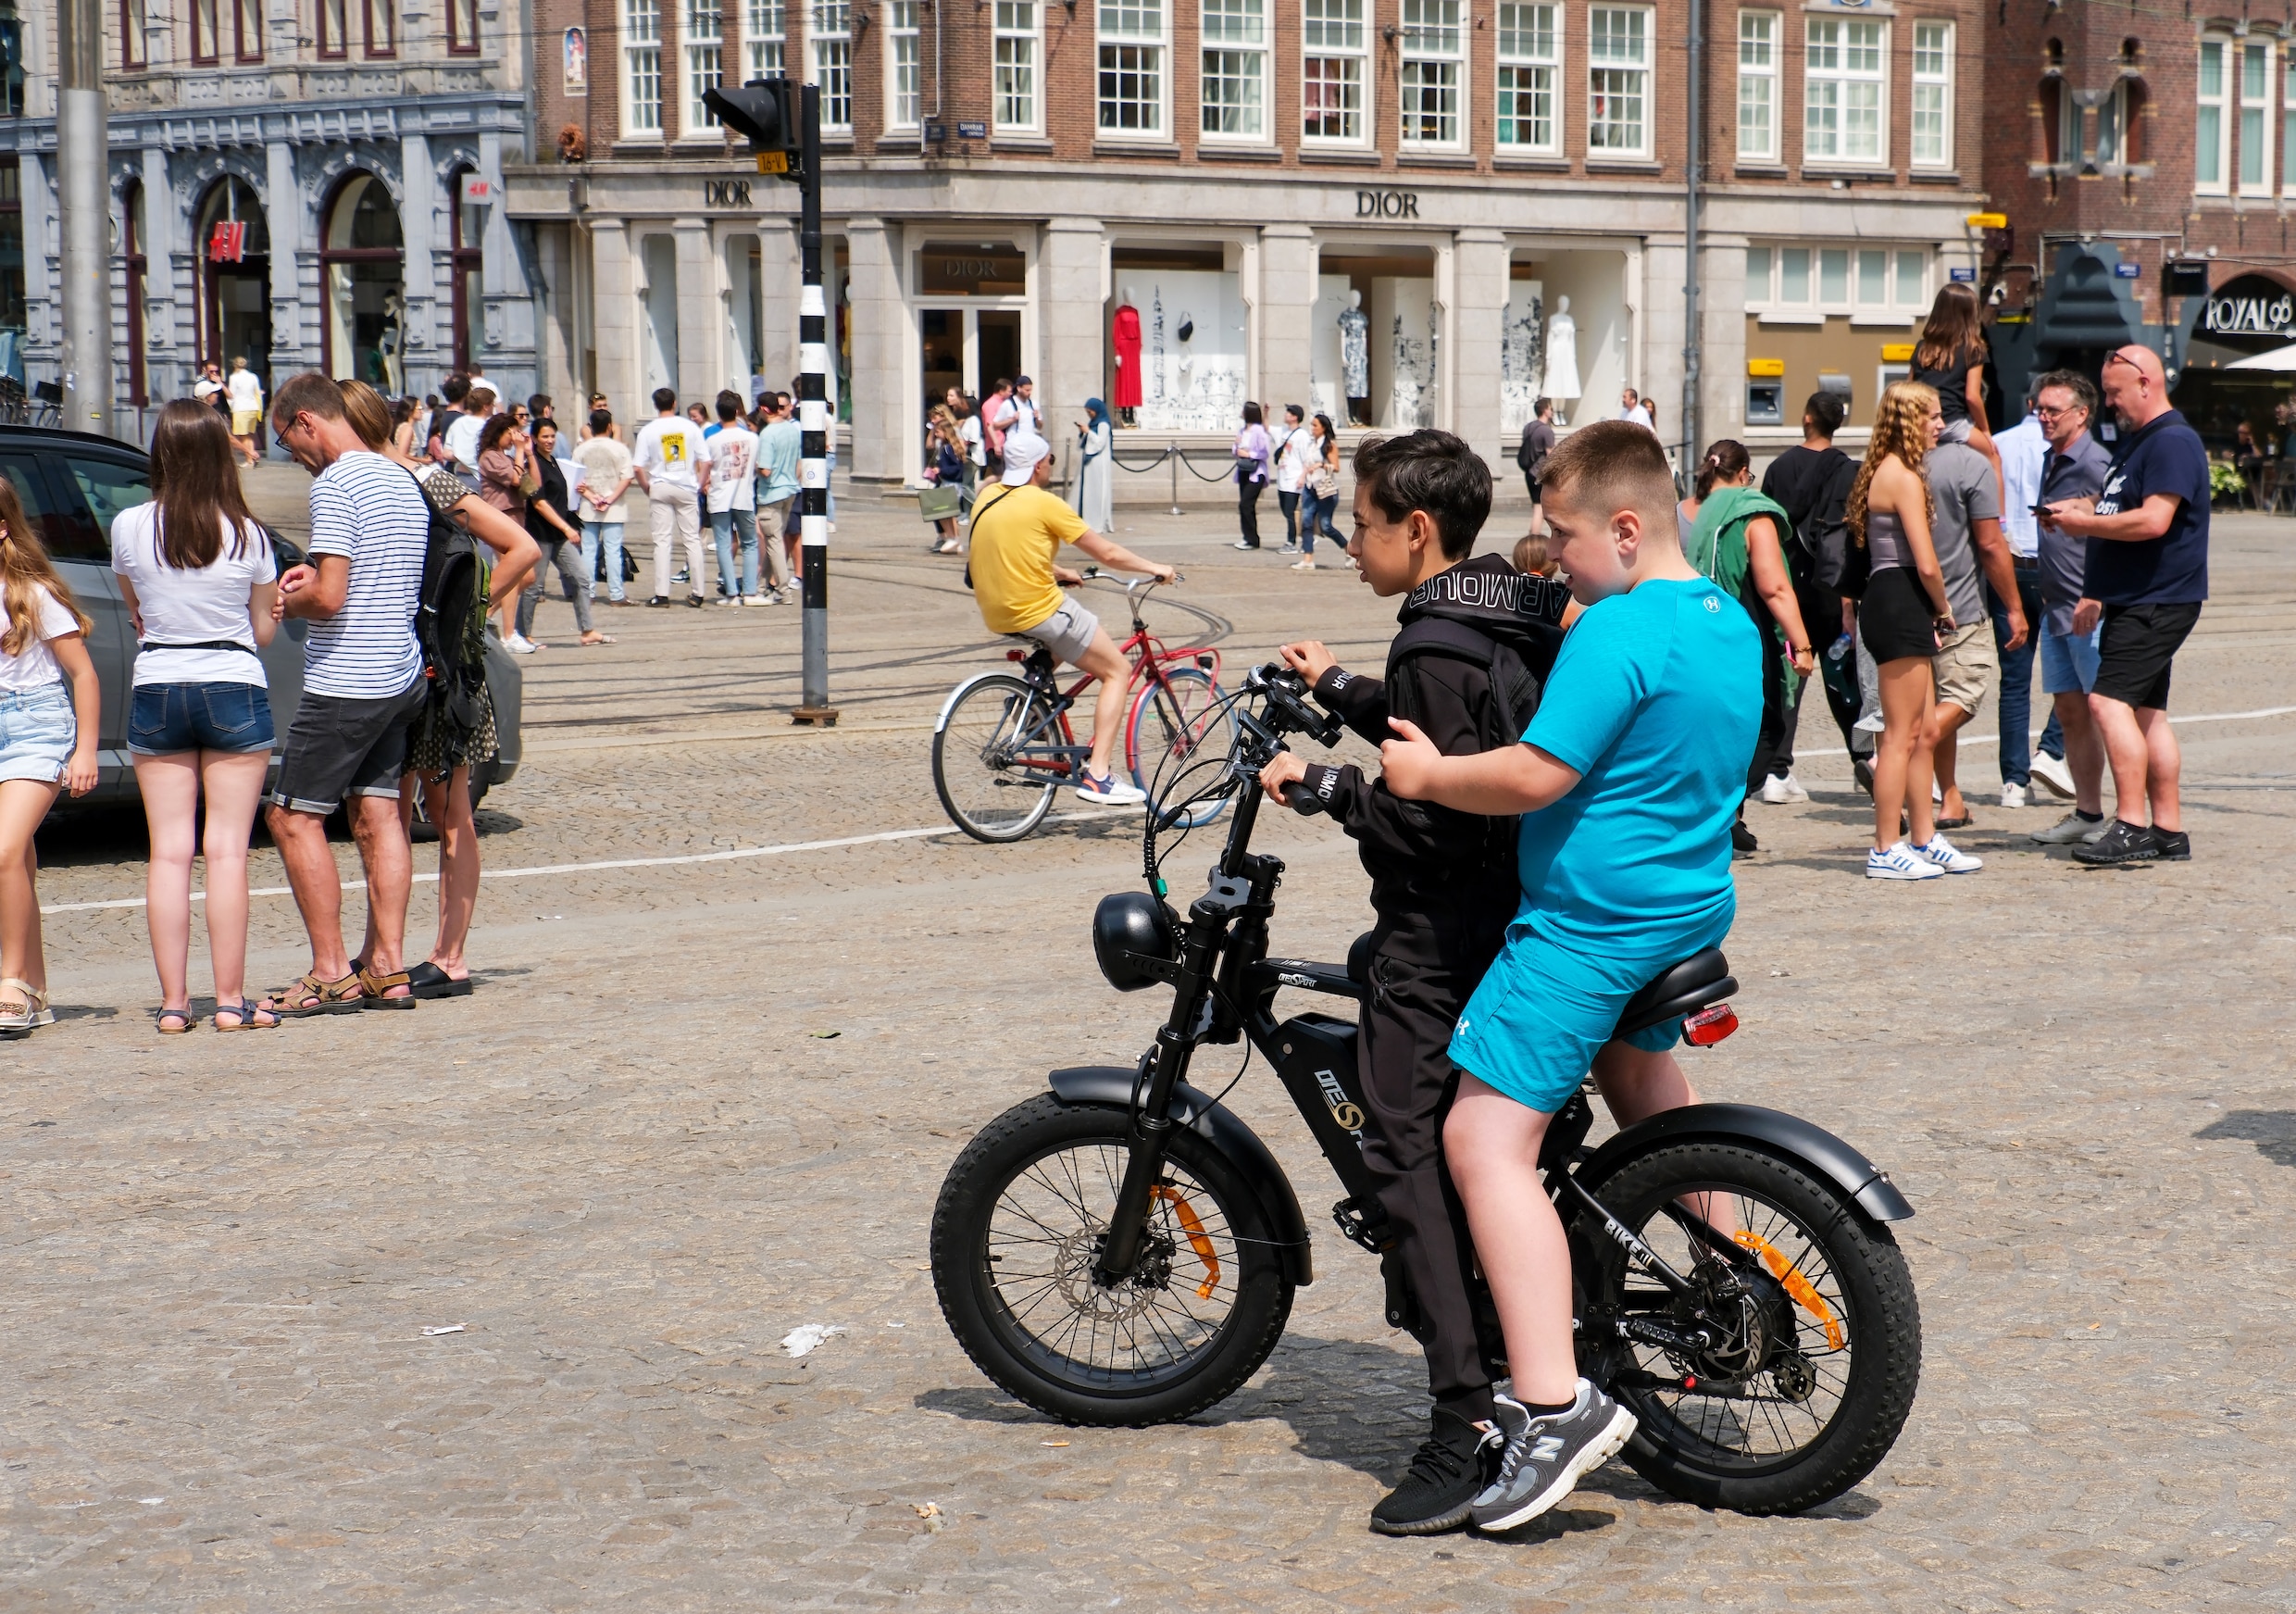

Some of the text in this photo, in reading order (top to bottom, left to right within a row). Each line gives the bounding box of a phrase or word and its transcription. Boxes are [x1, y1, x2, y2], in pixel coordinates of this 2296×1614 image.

[705, 181, 753, 208] DIOR
[1354, 191, 1419, 219] DIOR
[945, 259, 997, 277] DIOR
[1603, 1218, 1643, 1257] BIKE
